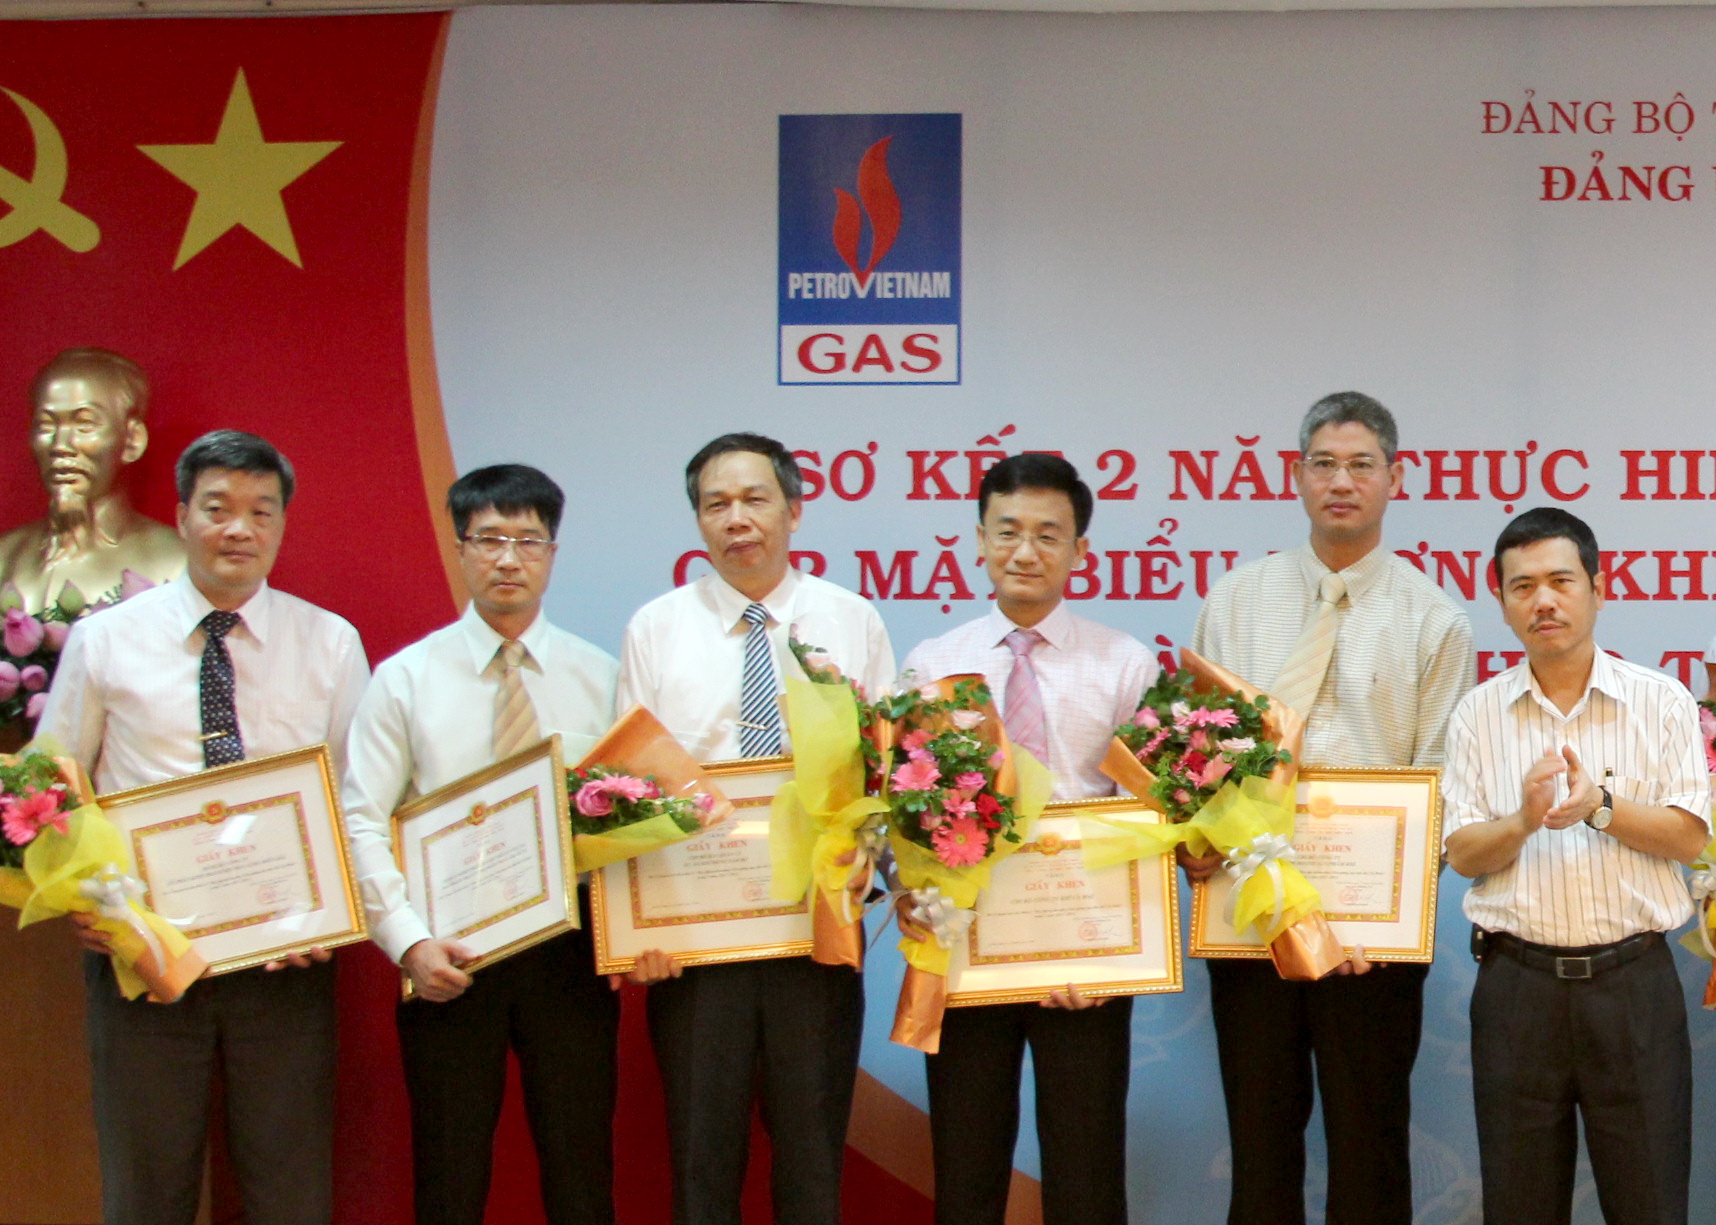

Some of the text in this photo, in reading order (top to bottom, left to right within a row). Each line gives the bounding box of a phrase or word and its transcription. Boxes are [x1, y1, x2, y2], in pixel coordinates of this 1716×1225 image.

[1482, 91, 1616, 135] ĐẢNG
[1632, 92, 1696, 142] BỘ
[1539, 150, 1695, 202] ĐẢNG
[788, 271, 951, 299] PETROVIETNAM
[797, 333, 943, 374] GAS
[790, 441, 879, 502] SƠ
[906, 424, 1065, 501] KẾ
[1096, 449, 1140, 500] 2
[854, 535, 994, 614] MẶ
